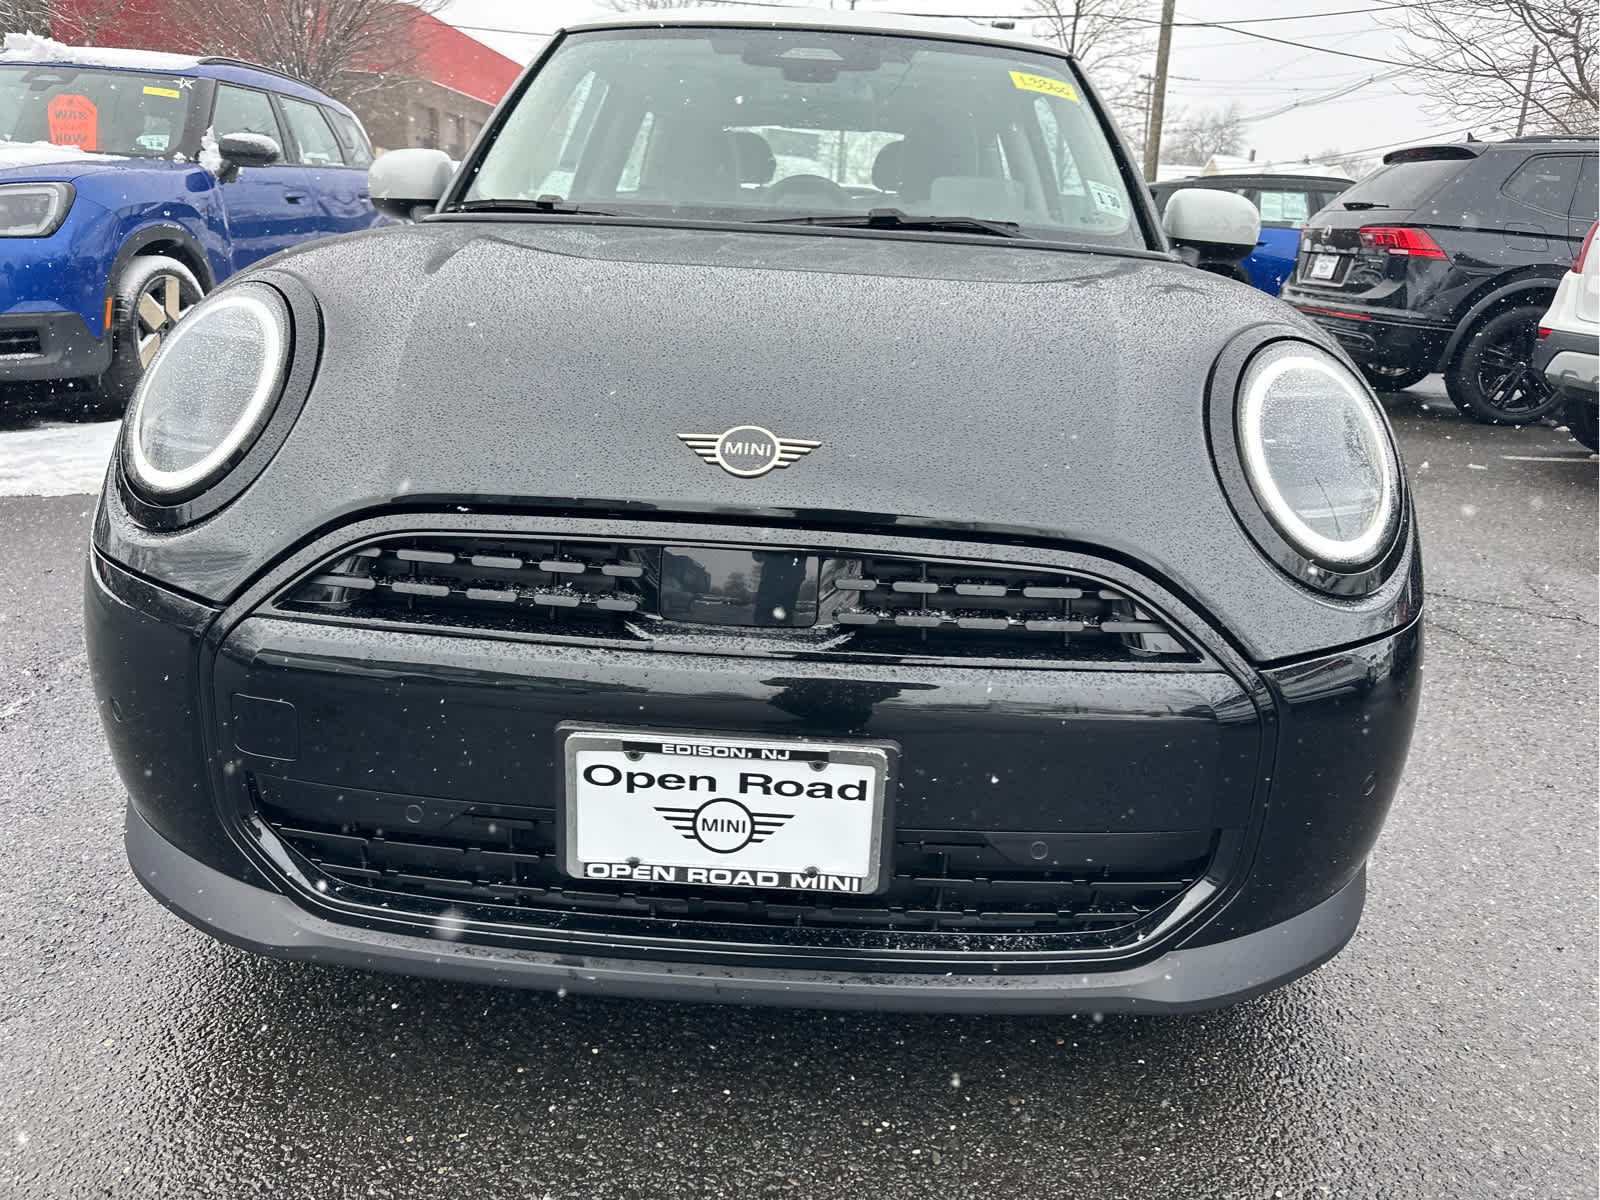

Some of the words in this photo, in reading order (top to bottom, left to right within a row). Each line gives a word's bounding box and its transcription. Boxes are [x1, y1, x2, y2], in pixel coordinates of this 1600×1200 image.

[724, 441, 772, 457] MINI
[661, 743, 752, 759] EDISON,
[760, 749, 790, 761] NJ
[583, 764, 717, 794] Open
[739, 772, 868, 801] Road
[701, 818, 747, 834] MINI
[586, 862, 676, 882] OPEN
[687, 867, 780, 887] ROAD
[789, 873, 860, 892] MINI
